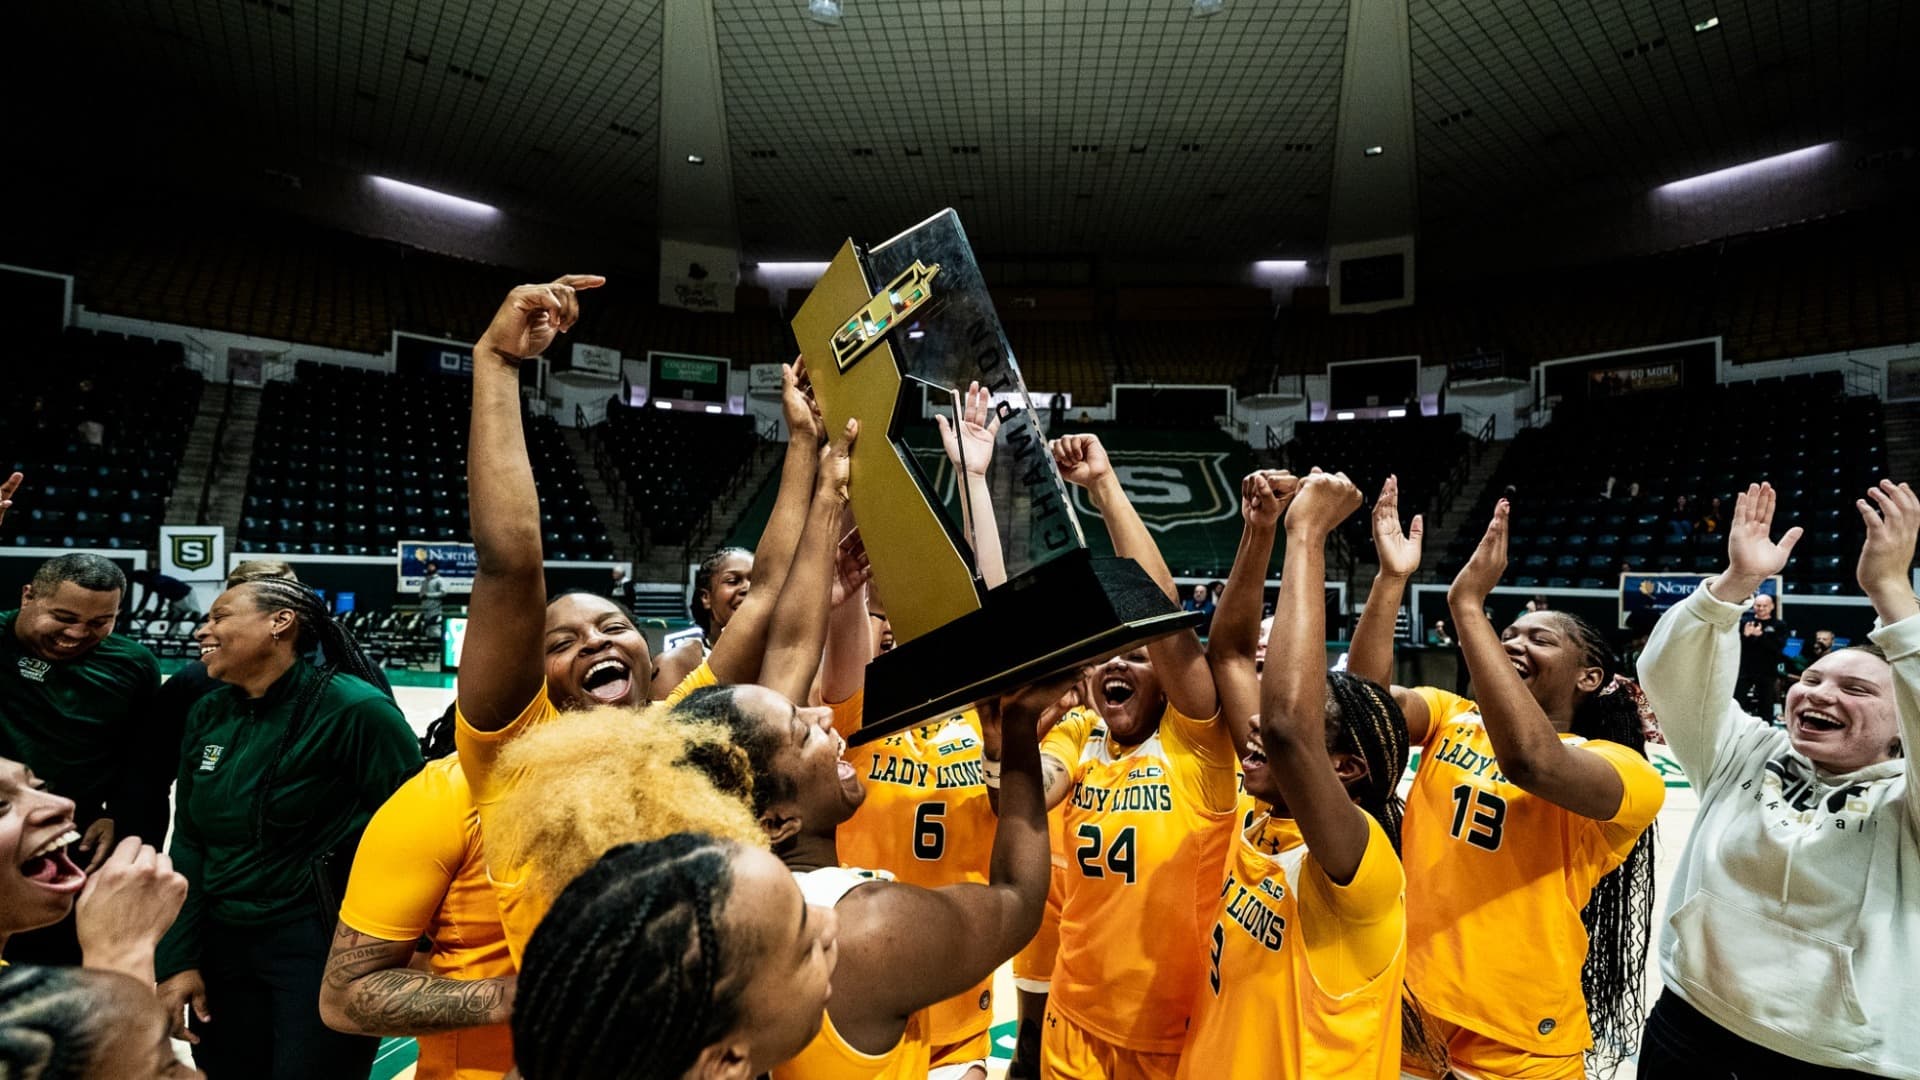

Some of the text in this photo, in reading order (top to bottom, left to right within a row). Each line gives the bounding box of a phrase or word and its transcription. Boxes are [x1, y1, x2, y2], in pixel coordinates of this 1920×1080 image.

[967, 316, 1071, 552] CHAMPION
[1113, 465, 1192, 504] S
[181, 541, 205, 562] S
[938, 738, 975, 757] SLC
[1435, 738, 1493, 776] LADY
[869, 754, 929, 787] LADY
[1128, 766, 1162, 781] SLC
[1072, 782, 1172, 812] ADY LIONS
[913, 801, 946, 861] 6
[1450, 784, 1508, 853] 13
[1077, 823, 1136, 884] 24
[1226, 886, 1286, 952] LIONS
